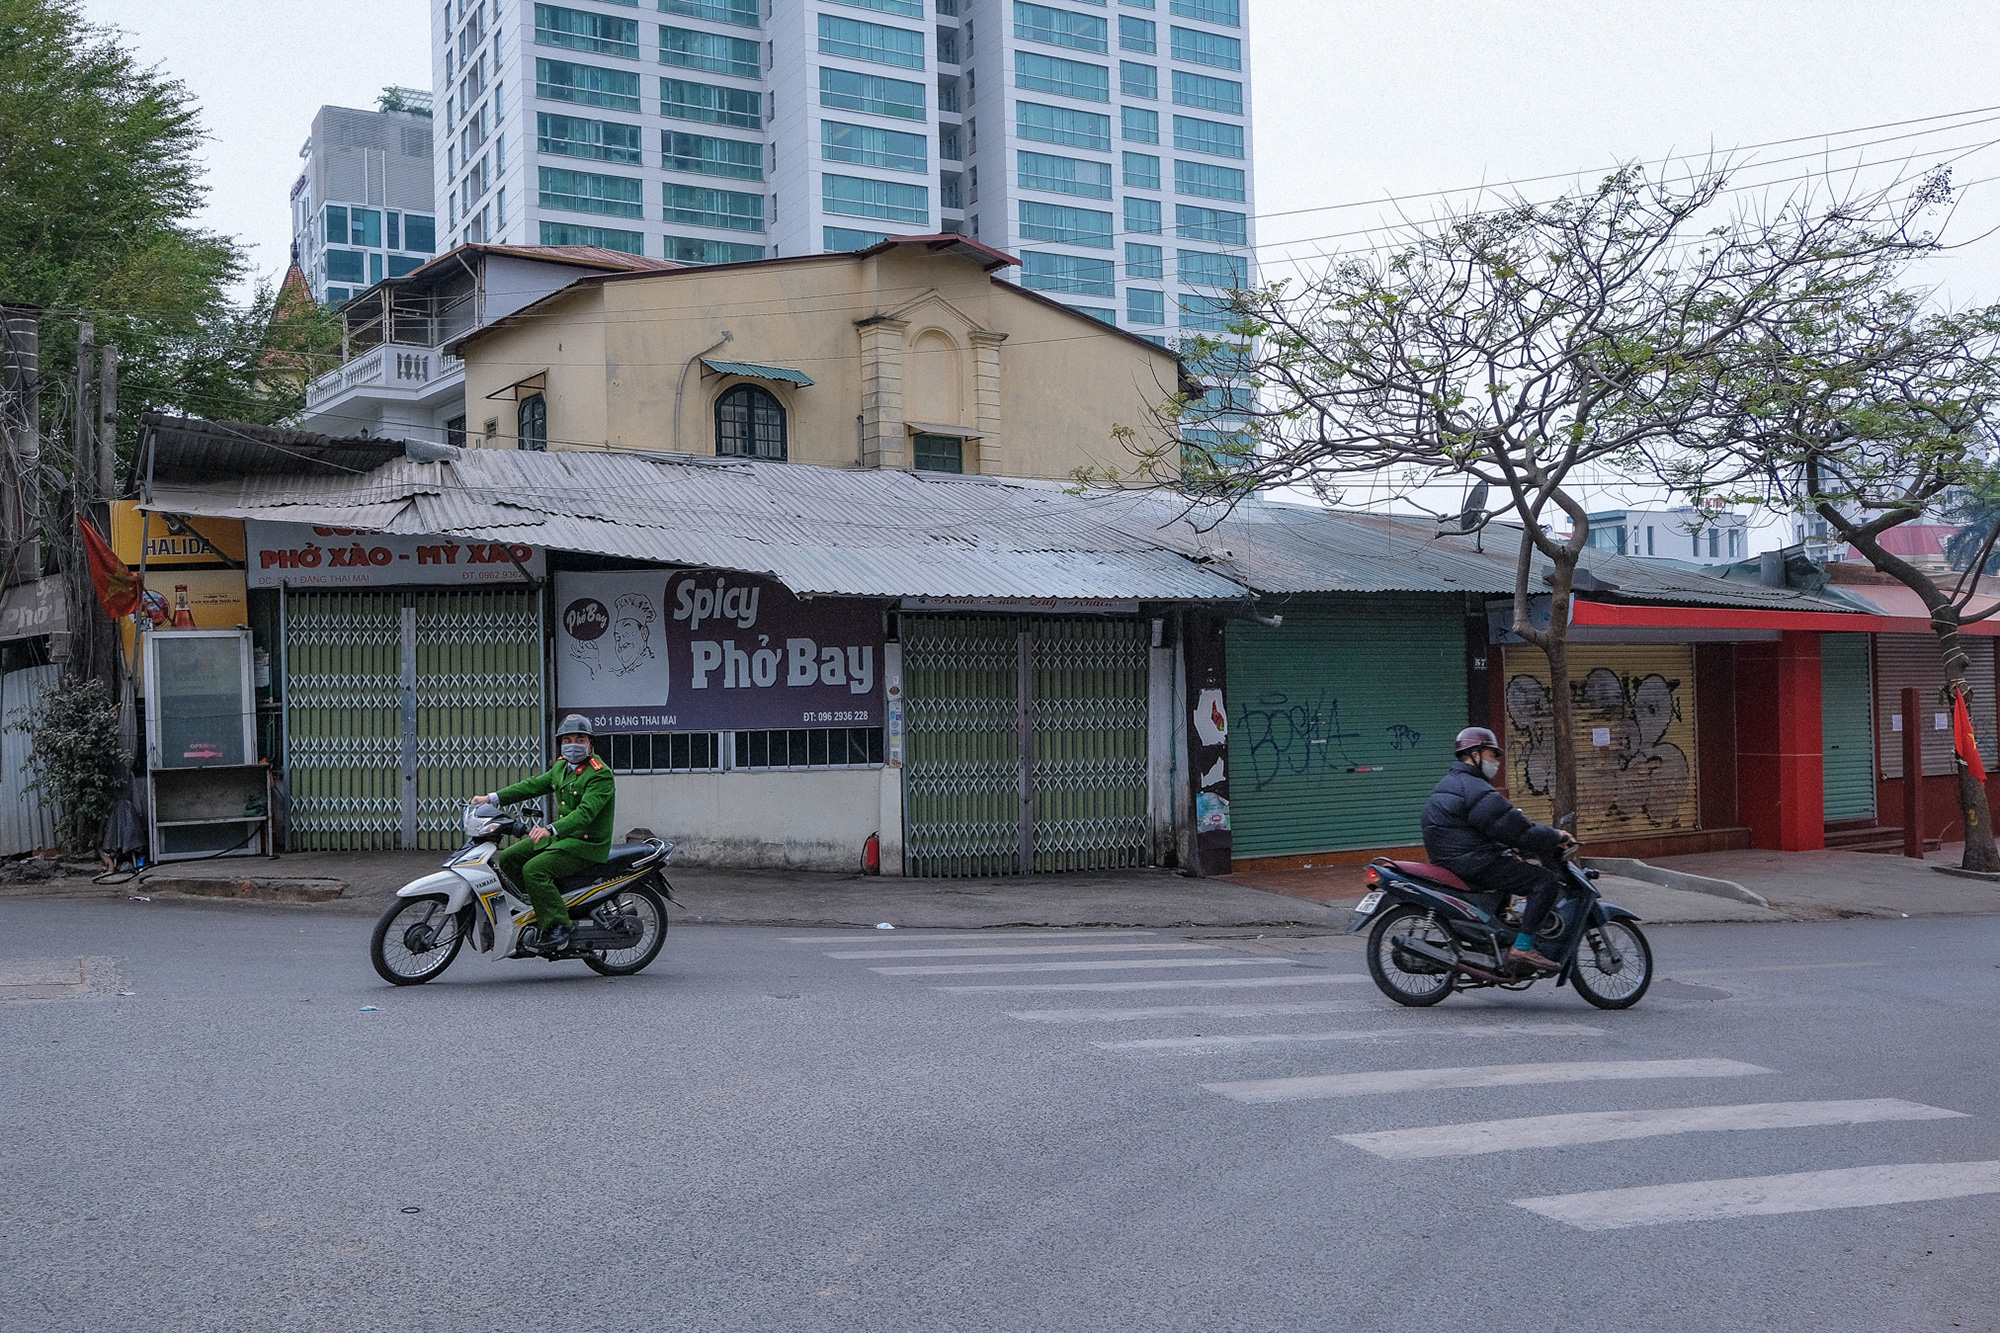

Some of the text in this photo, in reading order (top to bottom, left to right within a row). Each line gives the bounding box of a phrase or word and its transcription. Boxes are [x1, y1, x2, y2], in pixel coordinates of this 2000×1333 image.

[147, 537, 215, 556] HALIDA
[259, 542, 322, 569] PHỞ
[673, 577, 760, 630] Spicy
[586, 603, 608, 629] Bay
[691, 634, 874, 694] Phở Bay
[1475, 658, 1486, 667] 57
[608, 716, 613, 726] 1
[640, 715, 660, 726] THAI
[661, 715, 677, 725] MAI
[803, 710, 869, 722] ĐT: 096 2936 228
[475, 877, 497, 889] YAMAHA
